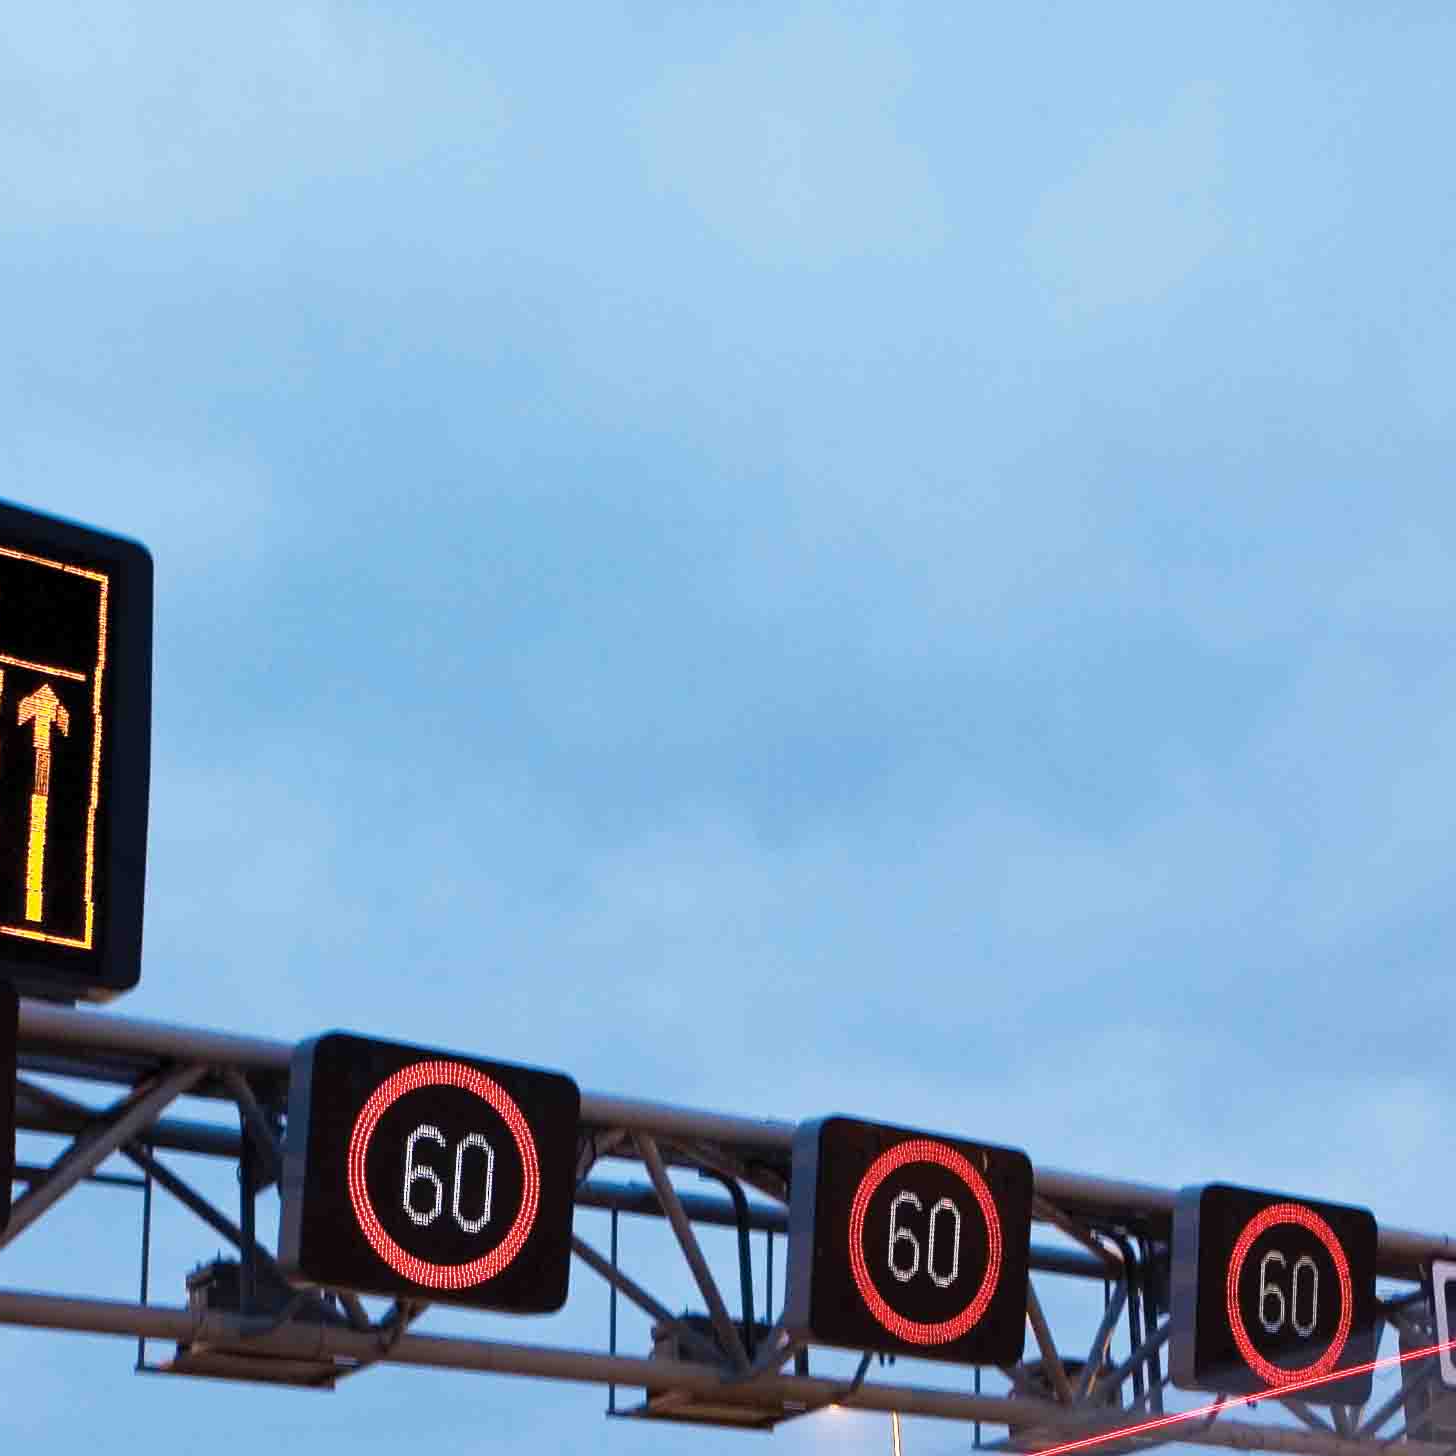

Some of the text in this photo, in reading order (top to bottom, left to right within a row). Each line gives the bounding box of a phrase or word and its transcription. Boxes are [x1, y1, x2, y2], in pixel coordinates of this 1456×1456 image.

[402, 1123, 496, 1235] 60
[887, 1190, 962, 1288] 60
[1258, 1249, 1320, 1338] 60
